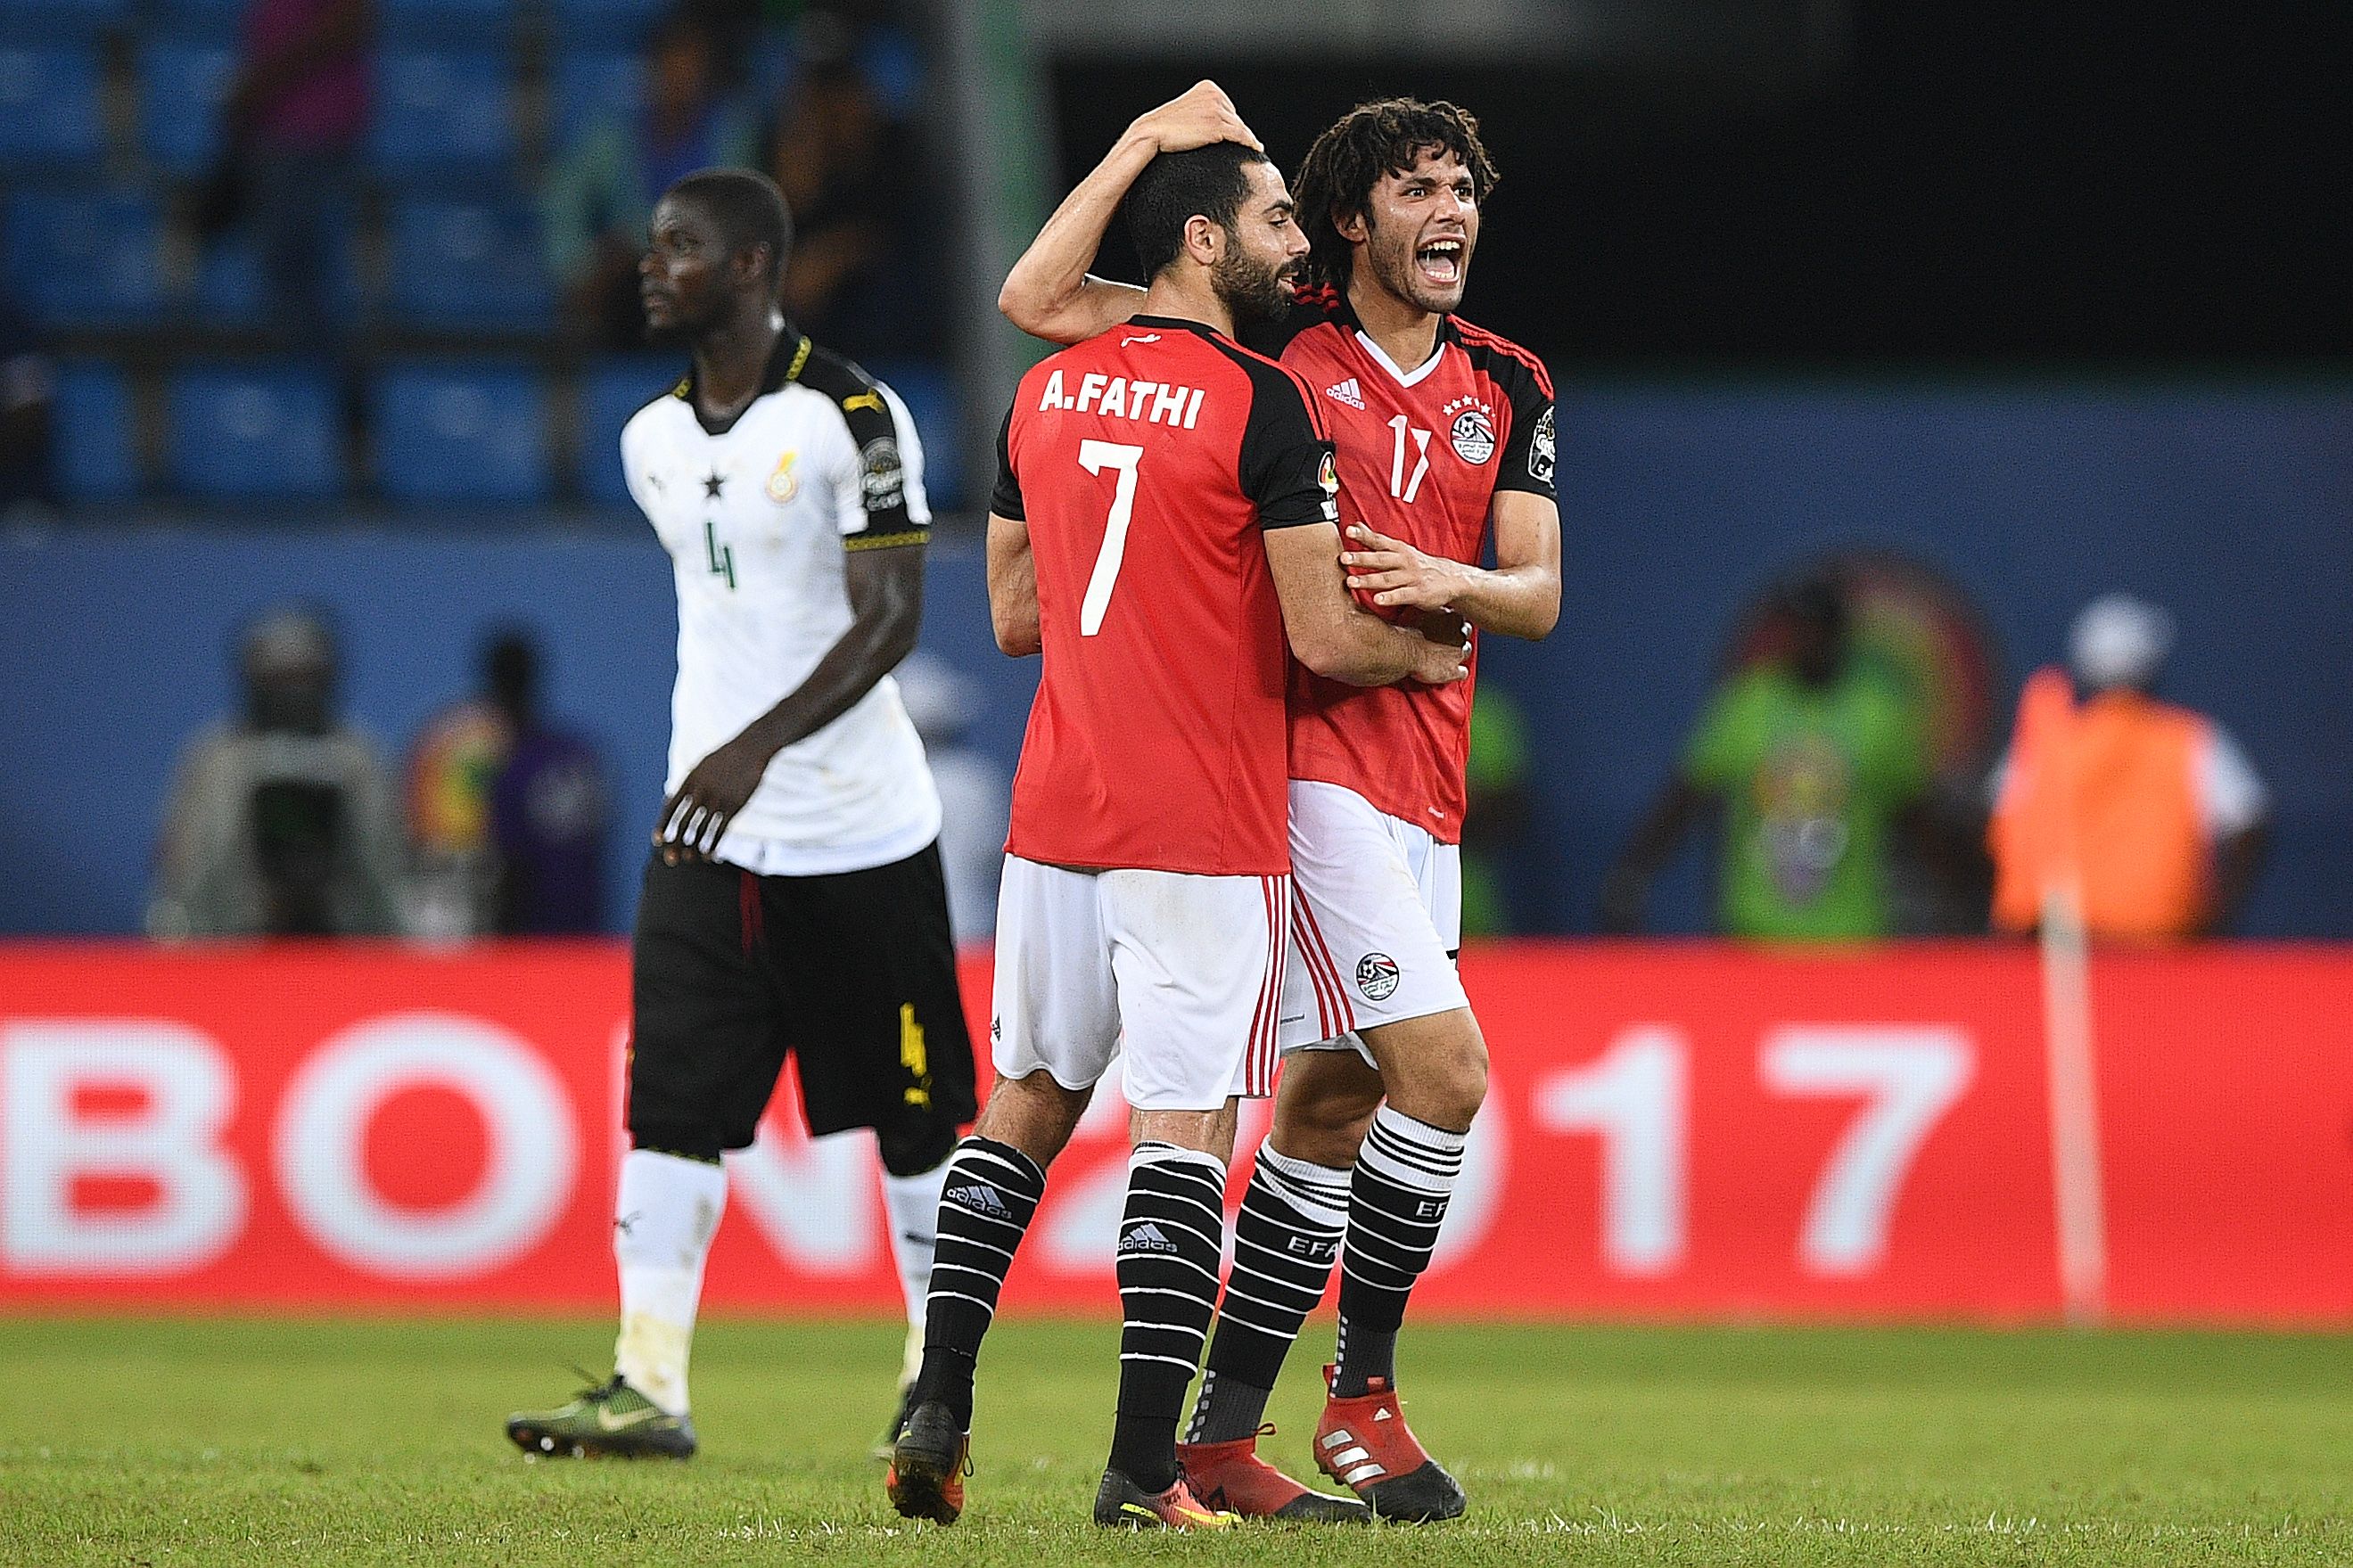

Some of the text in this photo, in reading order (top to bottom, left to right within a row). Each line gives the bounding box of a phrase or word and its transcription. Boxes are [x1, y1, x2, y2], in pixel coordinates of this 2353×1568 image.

[1038, 369, 1205, 430] A.FATHI
[1326, 388, 1366, 411] adidas
[1386, 415, 1433, 504] 17
[705, 521, 736, 589] 4
[1077, 438, 1145, 636] 7
[900, 1001, 927, 1077] 4
[1037, 1027, 1972, 1277] 17
[946, 1188, 1013, 1219] adidas
[1118, 1238, 1178, 1253] adidas
[1287, 1236, 1339, 1259] EFA
